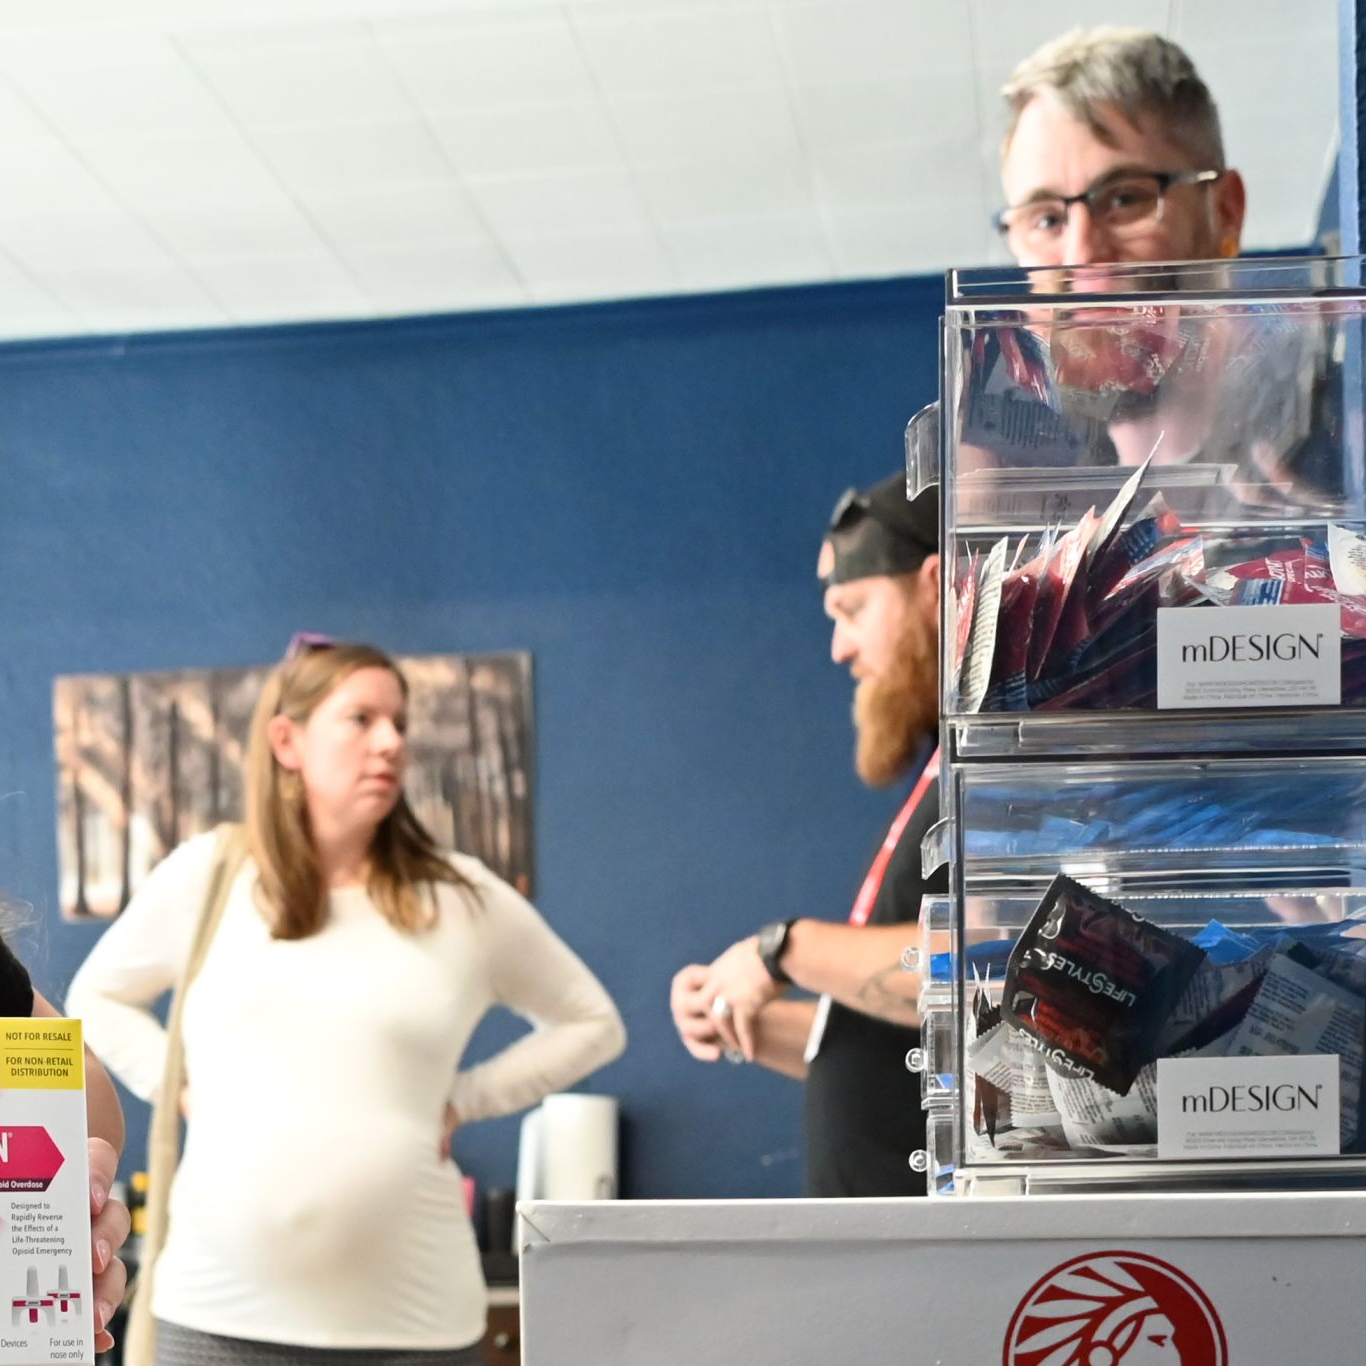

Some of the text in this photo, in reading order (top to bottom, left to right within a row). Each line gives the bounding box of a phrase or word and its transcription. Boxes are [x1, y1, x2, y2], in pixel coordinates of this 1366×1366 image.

[1182, 633, 1320, 663] mDESIGN
[1046, 951, 1137, 1008] LIFESTYLES
[6, 1032, 72, 1041] NOT FOR RESALE
[6, 1056, 73, 1066] FOR NON-RETAIL
[11, 1067, 69, 1077] DISTRIBUTION
[1182, 1084, 1318, 1113] mDESIGN
[10, 1180, 43, 1189] Overdose
[10, 1202, 51, 1211] Designed to
[11, 1213, 63, 1222] Rapidly Reverse
[11, 1224, 23, 1232] the
[23, 1224, 45, 1232] Effects
[46, 1224, 54, 1232] of
[11, 1235, 65, 1245] Life-Threatening
[12, 1247, 73, 1256] Opioid Emergency
[0, 1338, 28, 1348] Devices
[49, 1338, 84, 1347] For use in
[68, 1350, 84, 1361] only
